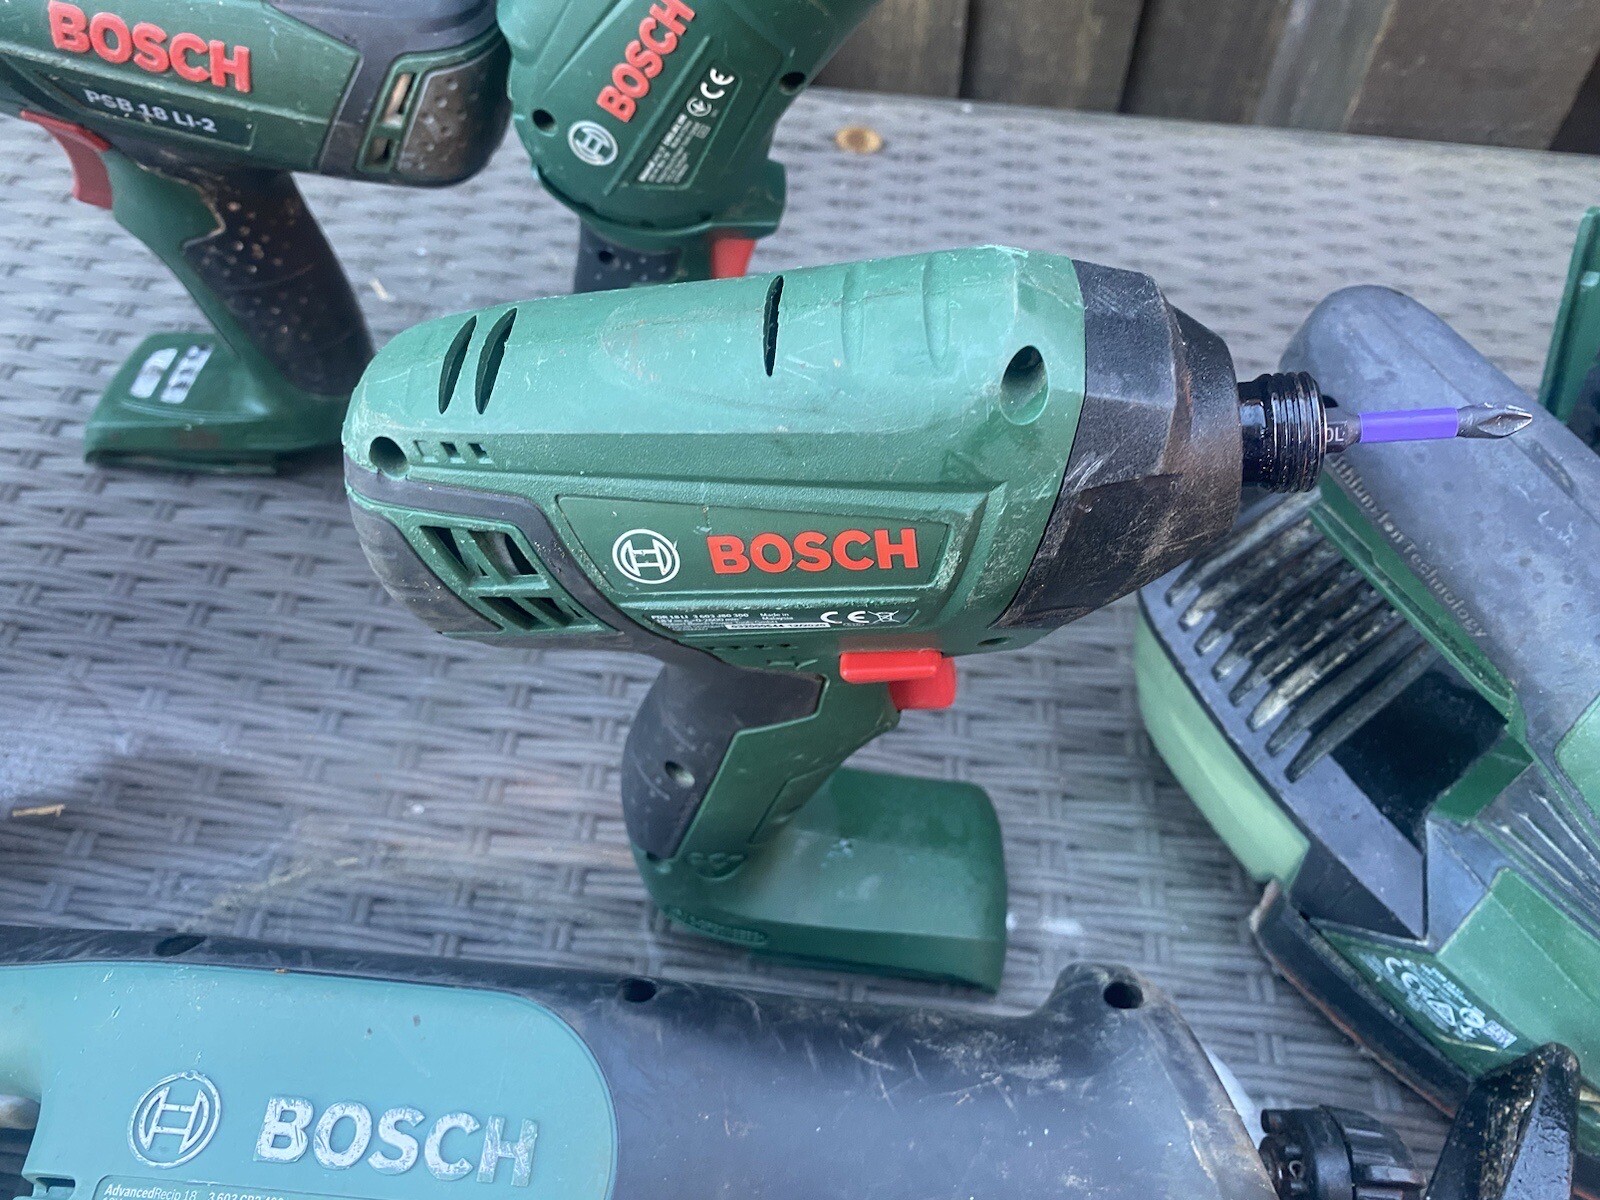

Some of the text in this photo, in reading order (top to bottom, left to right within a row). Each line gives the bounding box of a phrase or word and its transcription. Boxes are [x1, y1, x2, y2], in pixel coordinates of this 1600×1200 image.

[48, 2, 251, 93] BOSCH
[596, 0, 696, 123] BOSCH
[84, 89, 134, 112] PSB
[138, 103, 169, 122] 18
[706, 528, 919, 575] BOSCH
[1404, 541, 1487, 637] Technology
[253, 1095, 538, 1187] BOSCH
[104, 1184, 181, 1200] AdvancedRecip
[184, 1189, 198, 1200] 18
